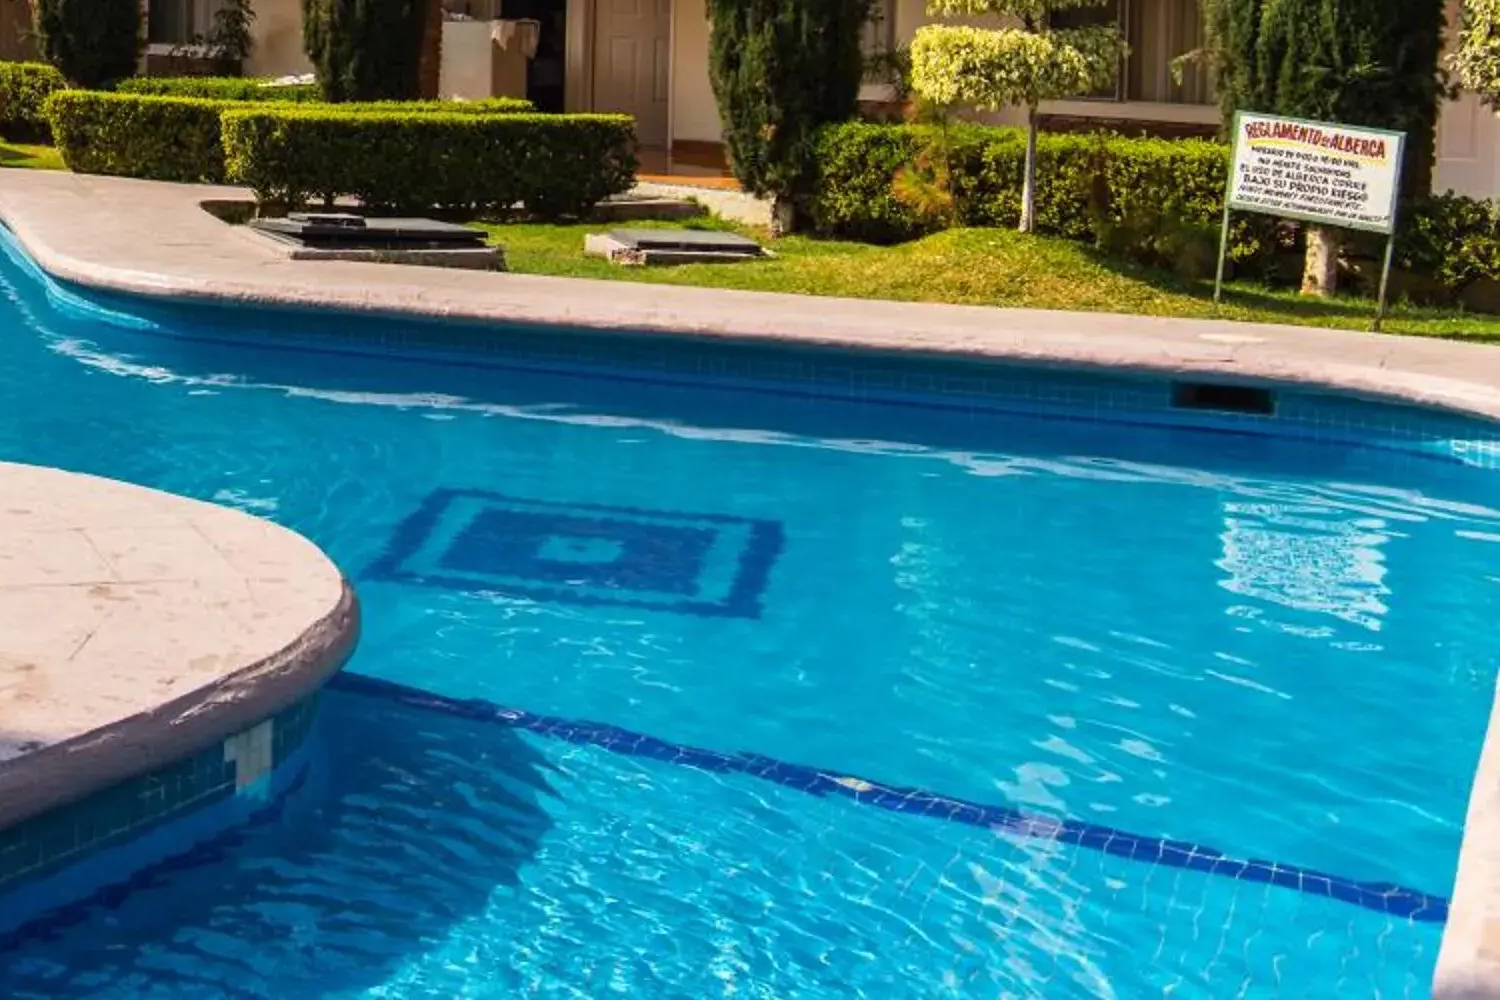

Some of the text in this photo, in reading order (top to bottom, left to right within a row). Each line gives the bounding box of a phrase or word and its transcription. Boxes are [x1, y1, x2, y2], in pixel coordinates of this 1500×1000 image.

[1245, 121, 1322, 145] REGLAMENTO
[1329, 133, 1385, 158] ALBERCA
[1243, 173, 1271, 186] BAJO
[1273, 179, 1287, 188] SU
[1289, 181, 1329, 196] PROPIO
[1331, 187, 1369, 202] RIESGO
[1285, 171, 1329, 185] ALBERCA
